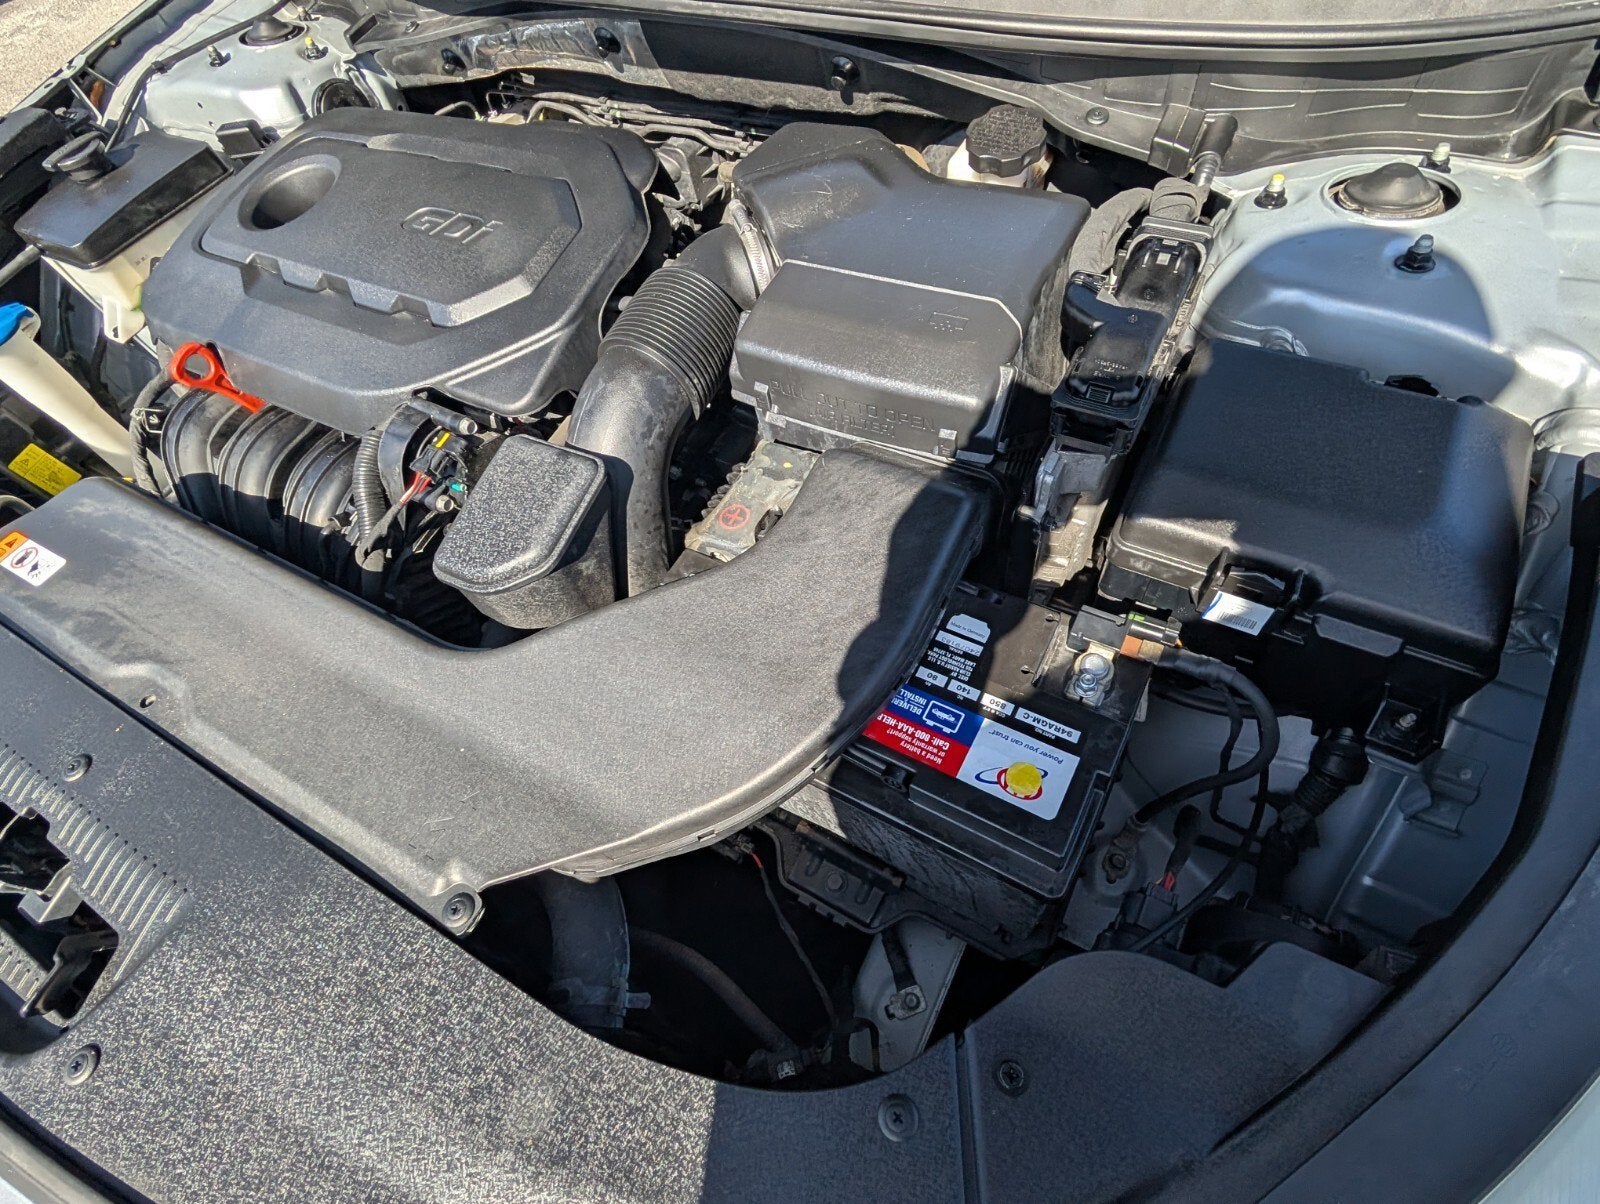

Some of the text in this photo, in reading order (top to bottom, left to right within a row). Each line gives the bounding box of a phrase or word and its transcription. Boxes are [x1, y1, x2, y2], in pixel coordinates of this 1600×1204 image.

[400, 206, 504, 244] GDi
[884, 406, 936, 432] OPEN
[926, 672, 939, 681] 80
[956, 684, 971, 695] 140
[990, 698, 1007, 710] 850
[1022, 712, 1074, 738] 94RAGM-C
[886, 728, 912, 742] support?
[1010, 738, 1024, 746] can
[900, 740, 921, 755] battery
[912, 738, 938, 753] warranty
[931, 736, 950, 750] Call:
[1023, 744, 1040, 753] you
[926, 753, 943, 765] Need
[1039, 749, 1064, 765] Power
